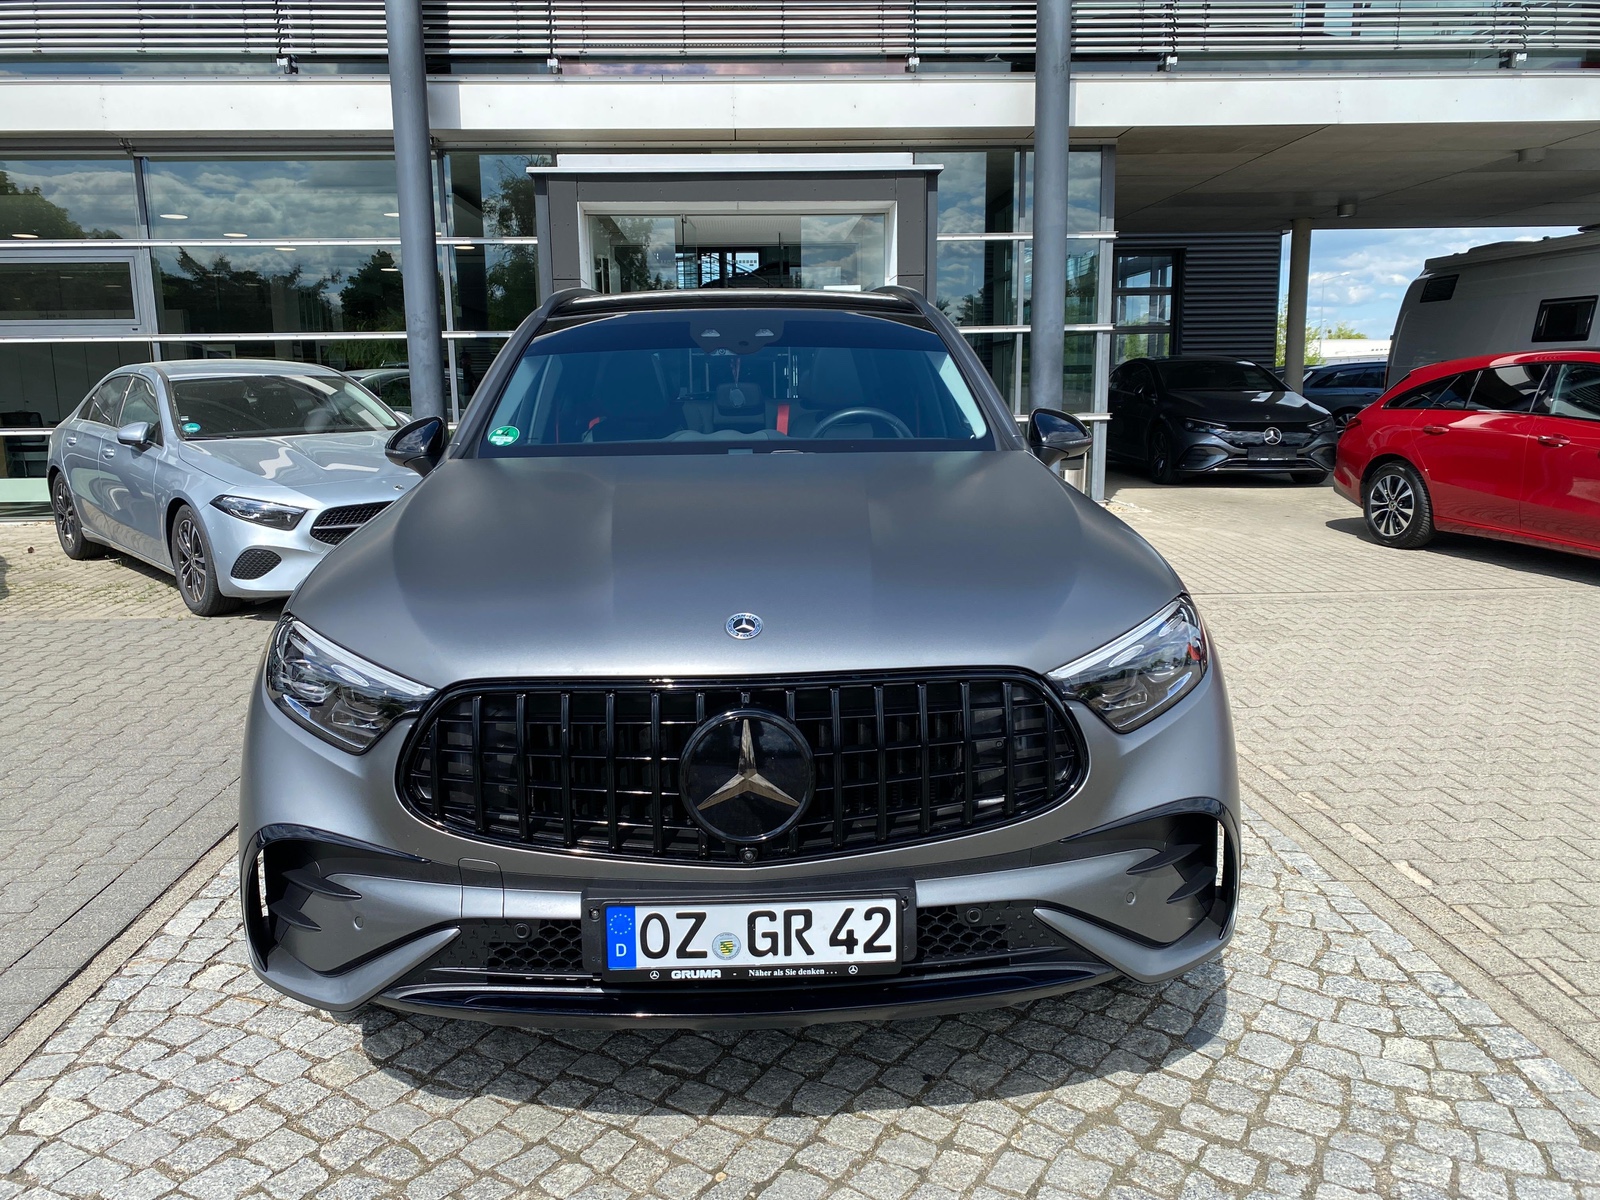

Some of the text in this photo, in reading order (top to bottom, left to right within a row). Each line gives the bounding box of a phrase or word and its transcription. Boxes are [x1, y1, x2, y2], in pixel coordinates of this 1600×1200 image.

[640, 911, 708, 959] OZ
[747, 909, 815, 957] GR
[829, 906, 892, 955] 42
[615, 943, 627, 957] D
[671, 969, 722, 979] GRUMA
[748, 969, 771, 977] Näher
[773, 968, 783, 976] als
[785, 968, 796, 976] Sie
